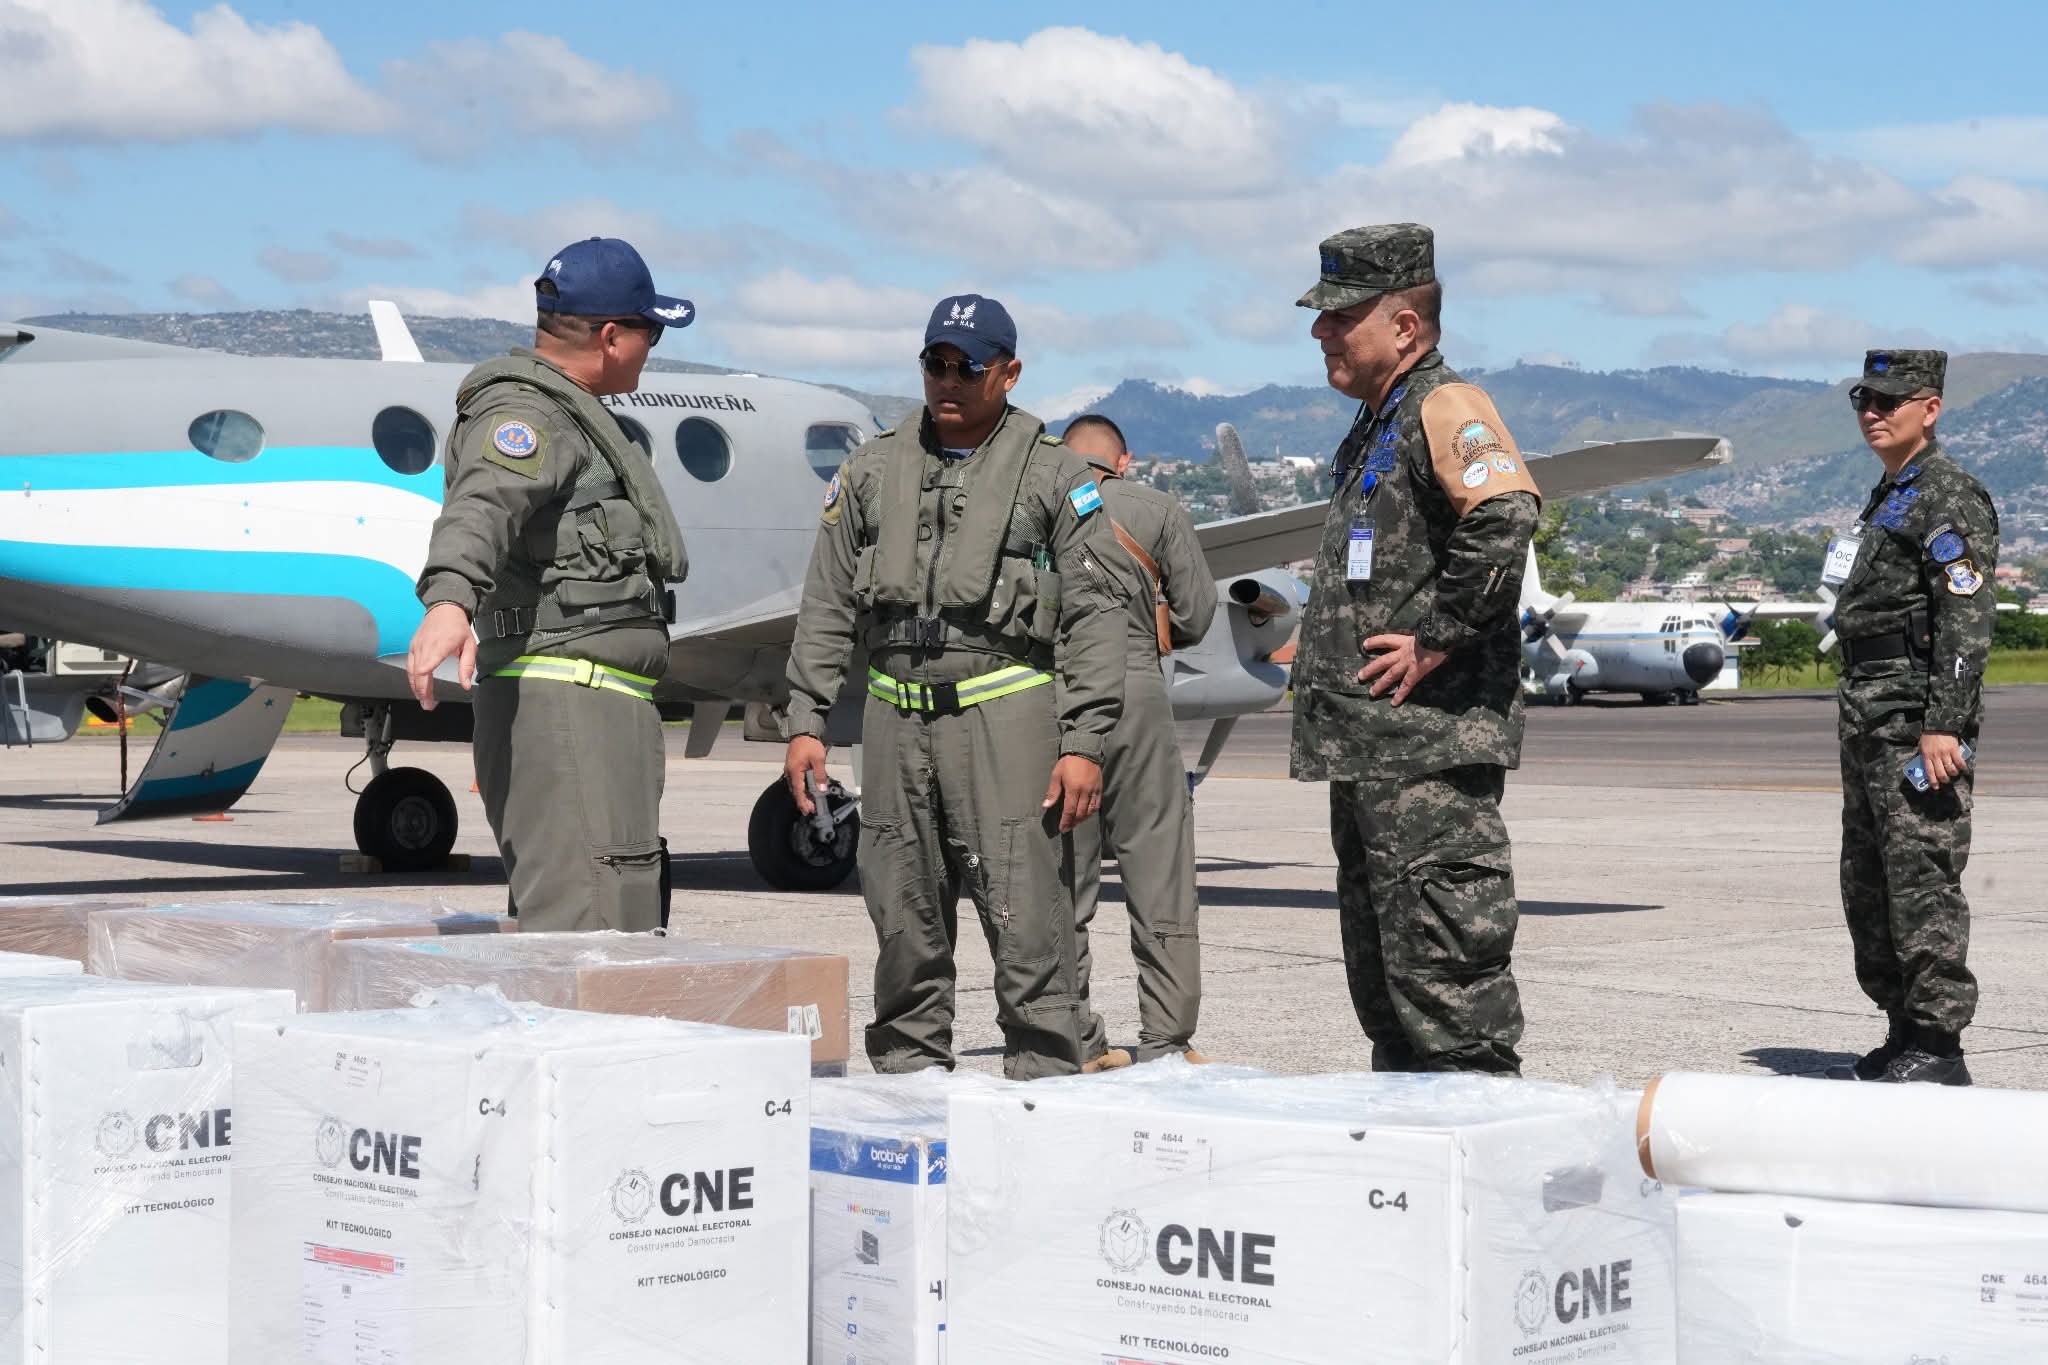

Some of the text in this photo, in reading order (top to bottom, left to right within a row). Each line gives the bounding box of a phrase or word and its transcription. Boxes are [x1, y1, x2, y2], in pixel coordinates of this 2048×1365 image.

[627, 393, 757, 412] HONDUREÑA
[479, 1098, 506, 1117] C-4
[765, 1099, 792, 1116] C-4
[145, 1108, 231, 1152] CNE
[1134, 1130, 1150, 1140] CNE
[349, 1127, 422, 1180] CNE
[871, 1146, 909, 1164] brother
[313, 1173, 418, 1198] CONSEJO NACIONAL ELECTORAL
[659, 1166, 755, 1217] CNE
[1369, 1188, 1409, 1212] C-4
[326, 1219, 339, 1230] KIT
[609, 1218, 752, 1241] CONSEJO NACIONAL ELECTORAL
[627, 1234, 736, 1254] Construyendo Democracia
[1156, 1223, 1276, 1287] CNE
[637, 1276, 655, 1288] KIT
[1554, 1258, 1632, 1324] CNE
[1981, 1273, 2006, 1285] CNE
[1096, 1278, 1272, 1308] CONSEJO NACIONAL ELECTORAL
[1117, 1296, 1250, 1322] Construyendo Democracia
[1120, 1334, 1230, 1358] KIT TECNOLÓGICO
[1512, 1322, 1631, 1357] CONSEJO NACIONAL ELECTORAL
